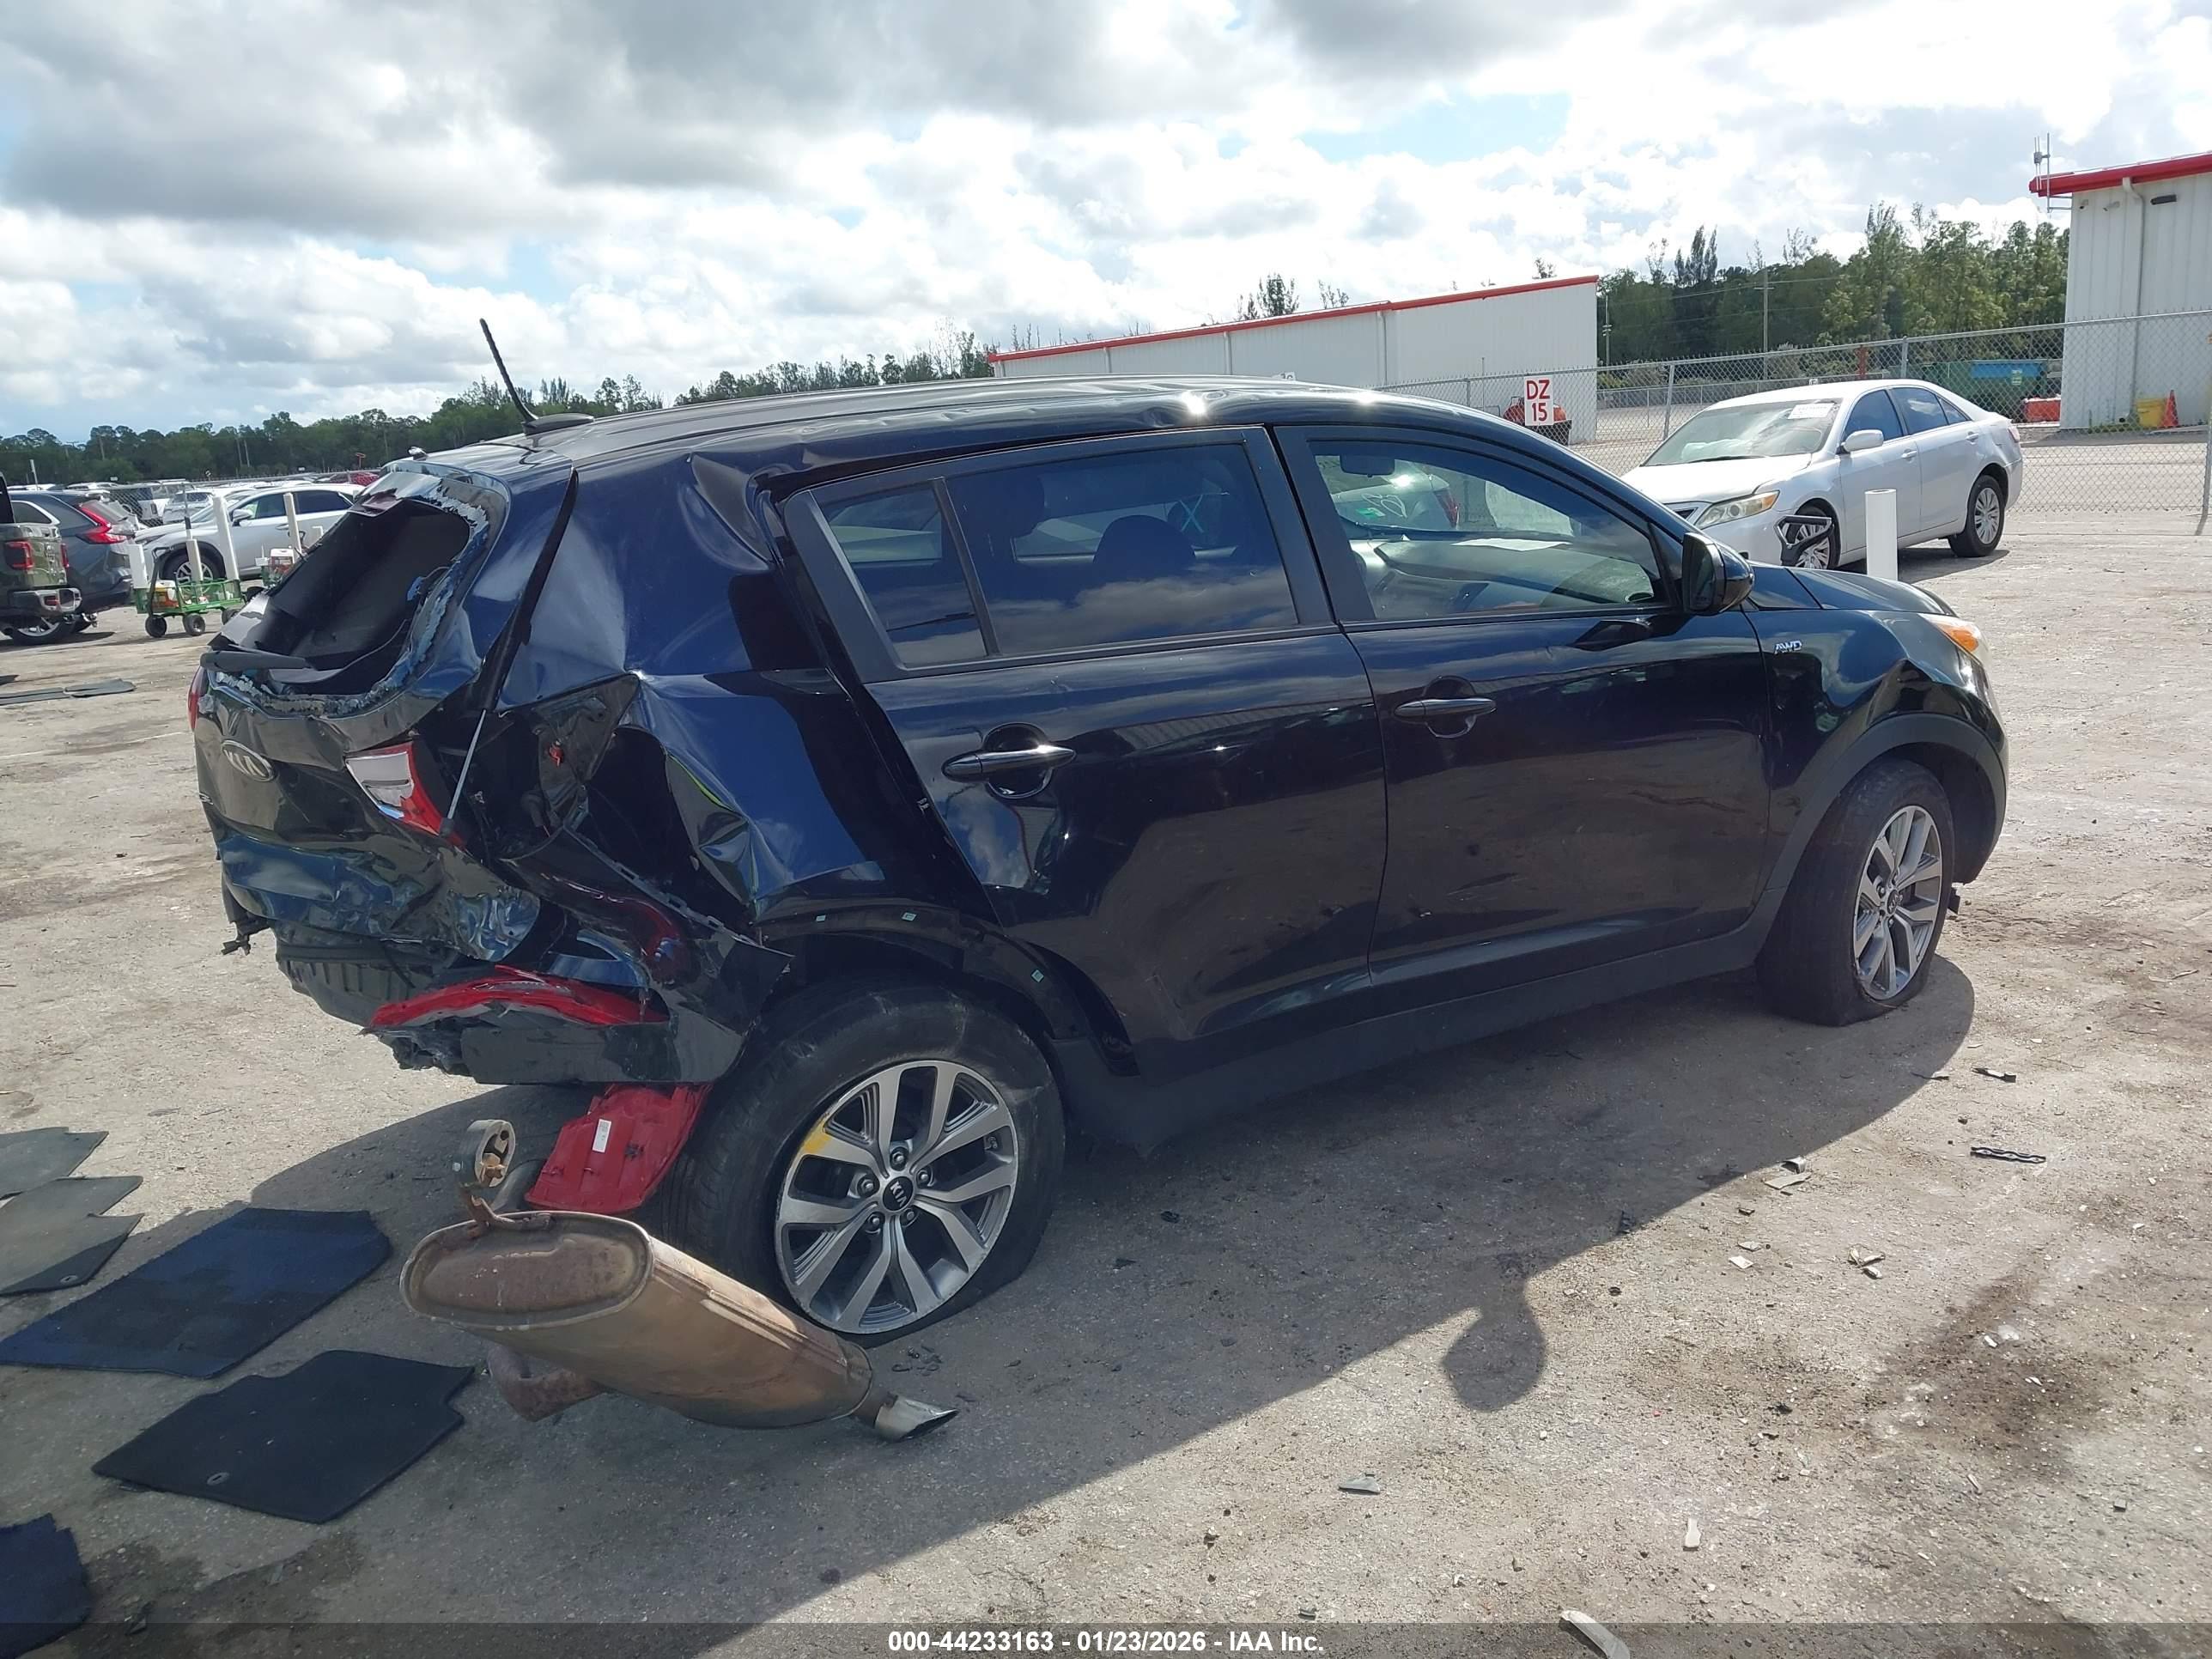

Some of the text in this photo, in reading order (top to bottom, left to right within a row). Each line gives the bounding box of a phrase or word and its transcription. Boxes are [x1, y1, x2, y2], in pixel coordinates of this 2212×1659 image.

[1526, 380, 1550, 400] DZ
[1532, 402, 1548, 422] 15
[1774, 640, 1803, 655] AWD
[223, 748, 266, 777] KIA
[890, 1181, 908, 1208] KIA
